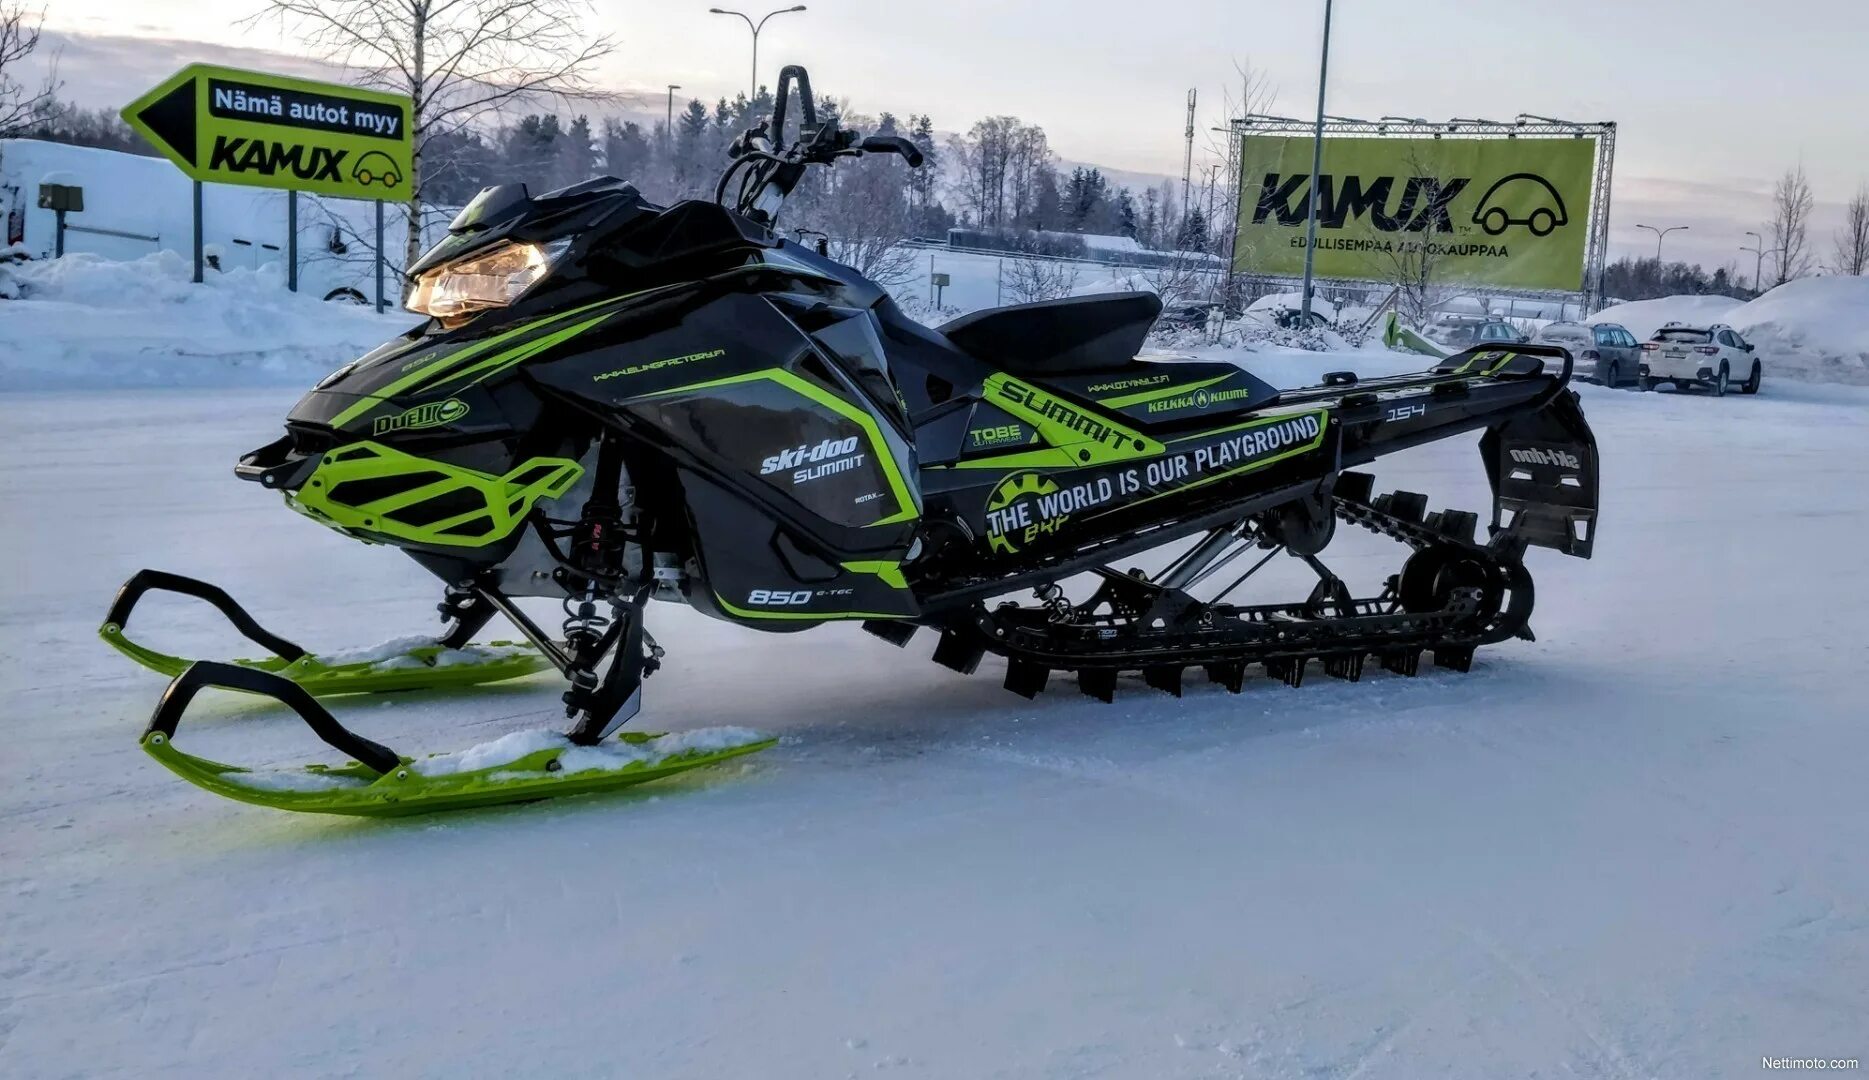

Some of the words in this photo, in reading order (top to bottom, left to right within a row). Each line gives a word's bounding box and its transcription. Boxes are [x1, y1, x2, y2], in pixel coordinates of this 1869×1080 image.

[215, 88, 283, 116] Nämä
[290, 101, 349, 125] autot
[355, 113, 398, 134] myy
[209, 136, 349, 182] KAMUX
[1252, 173, 1471, 233] KAMUX
[1397, 241, 1509, 258] AUOKAUPPAA
[998, 380, 1133, 451] SUMMIT
[1148, 397, 1194, 413] KELKKA
[1210, 388, 1249, 403] KUUME
[1385, 403, 1426, 423] 154
[970, 424, 1021, 443] TOBE
[759, 435, 859, 475] ski-doo
[793, 453, 865, 484] SUMMIT
[986, 502, 1031, 536] THE
[1037, 478, 1112, 520] WORLD
[1119, 470, 1140, 495] IS
[1146, 456, 1189, 487] OUR
[1195, 414, 1320, 473] PLAYGROUND
[747, 589, 813, 605] 850
